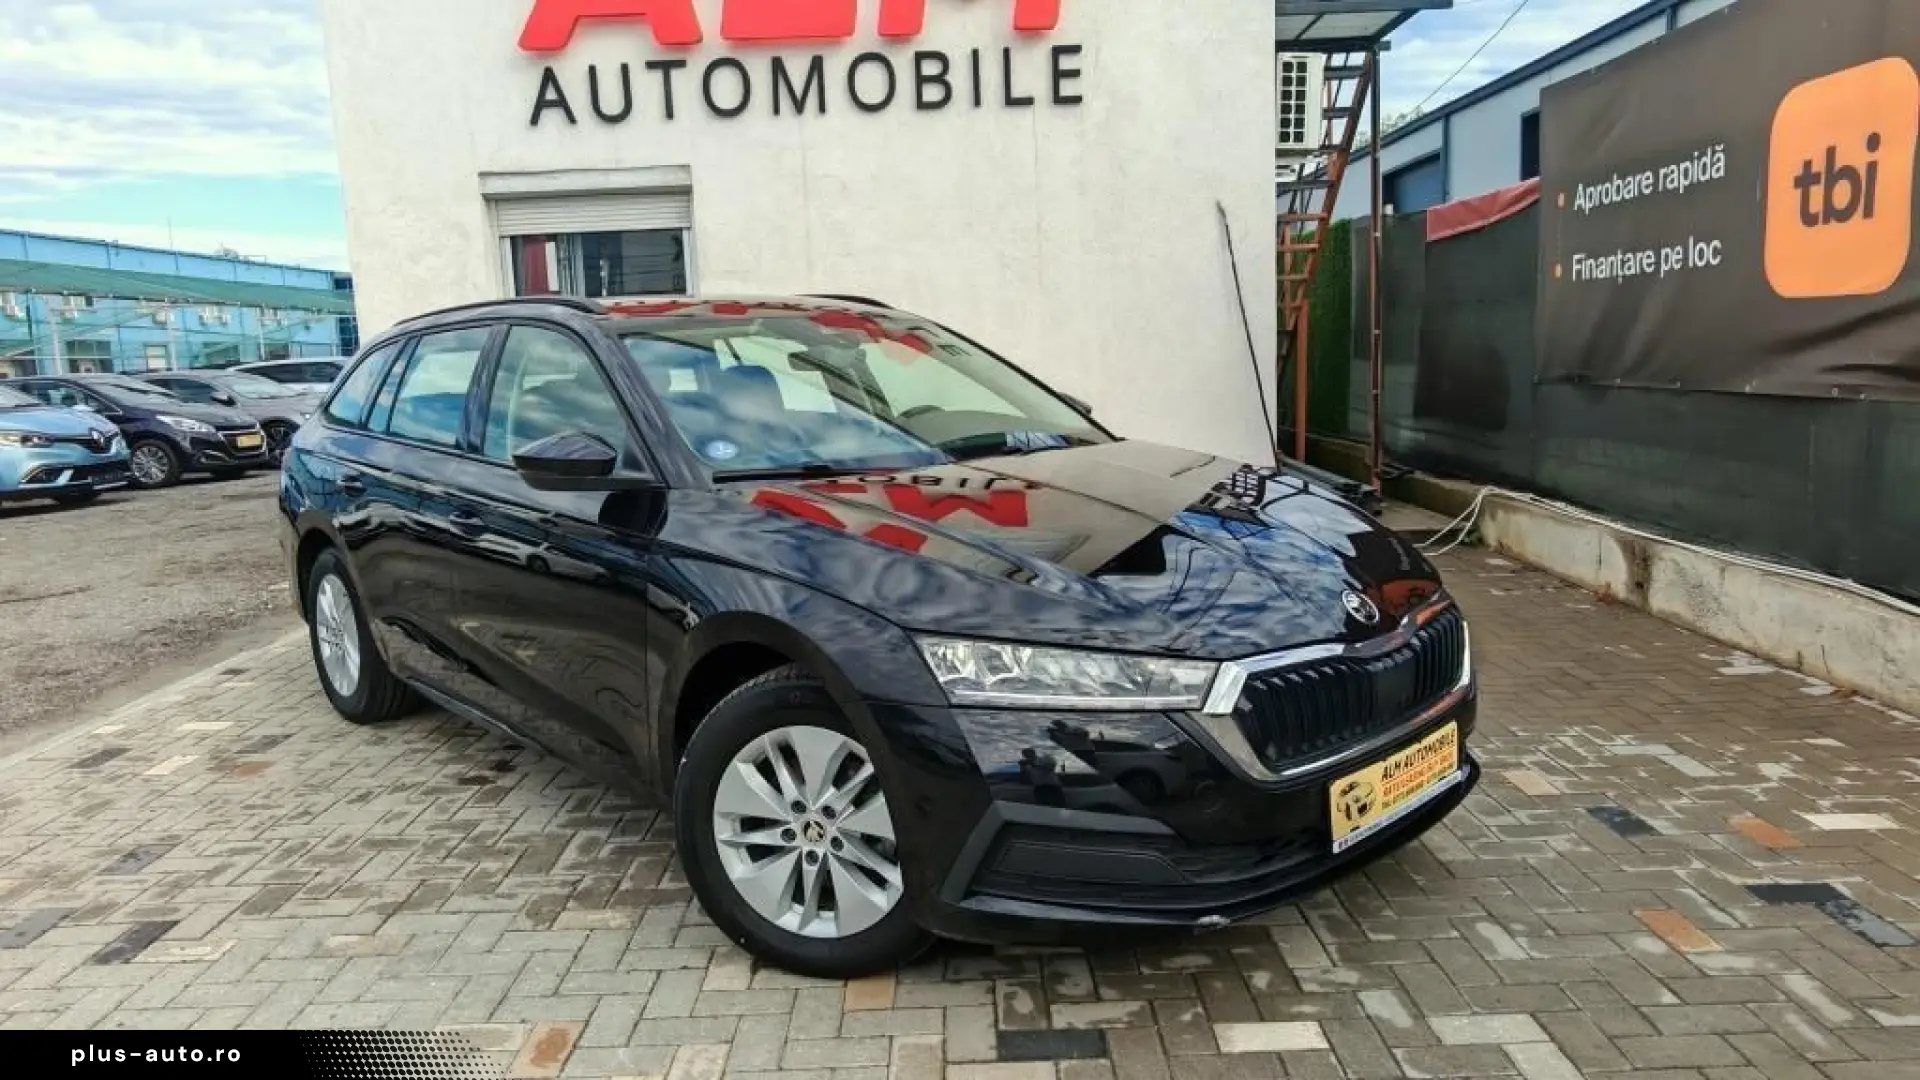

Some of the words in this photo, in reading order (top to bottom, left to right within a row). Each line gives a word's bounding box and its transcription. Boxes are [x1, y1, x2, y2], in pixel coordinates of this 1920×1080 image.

[530, 44, 1083, 126] AUTOMOBILE
[1573, 171, 1655, 215] Aprobare
[1658, 144, 1726, 194] rapidă
[1793, 132, 1881, 228] tbi
[1572, 250, 1655, 284] Finanțare
[1660, 246, 1683, 279] pe
[1688, 236, 1723, 268] loc
